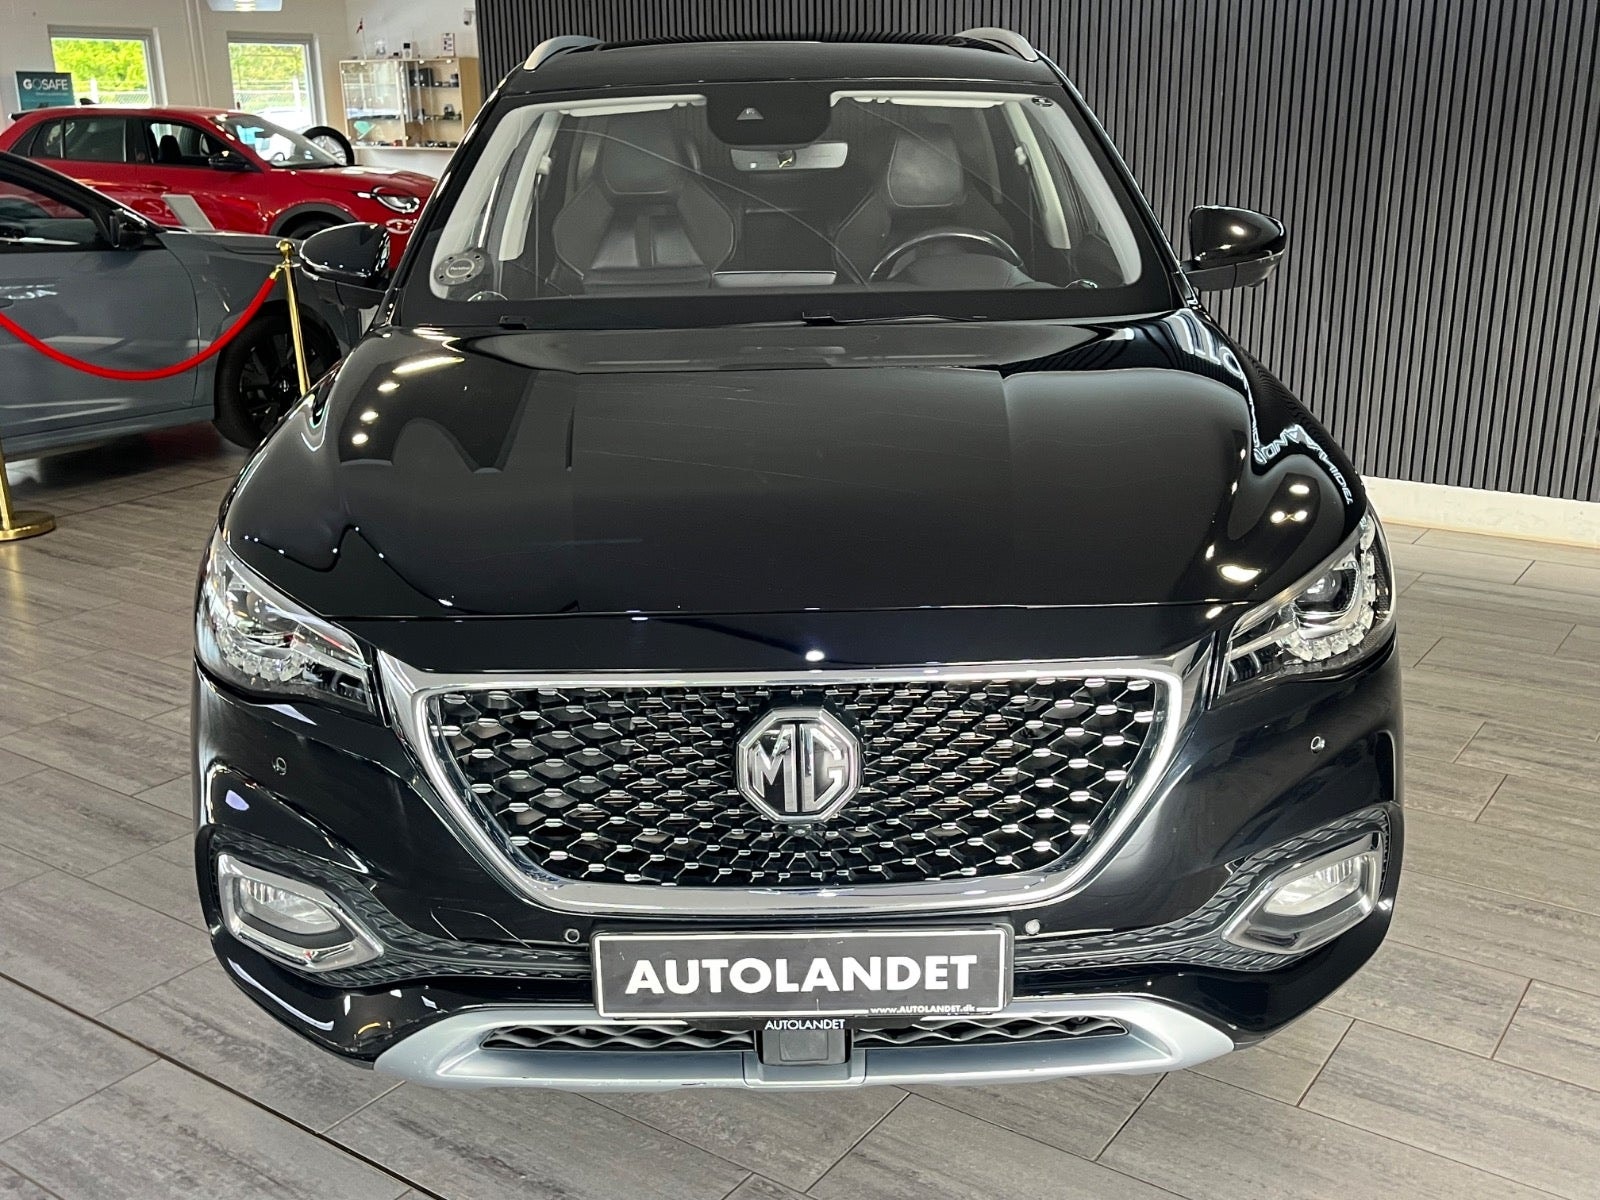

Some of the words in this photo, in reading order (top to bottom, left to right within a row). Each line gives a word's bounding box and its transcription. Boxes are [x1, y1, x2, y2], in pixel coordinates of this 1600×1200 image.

[752, 723, 846, 812] MG
[625, 955, 978, 994] AUTOLANDET
[870, 1004, 976, 1014] www.AUTOLANDET.dk
[764, 1019, 846, 1030] AUTOLANDET
